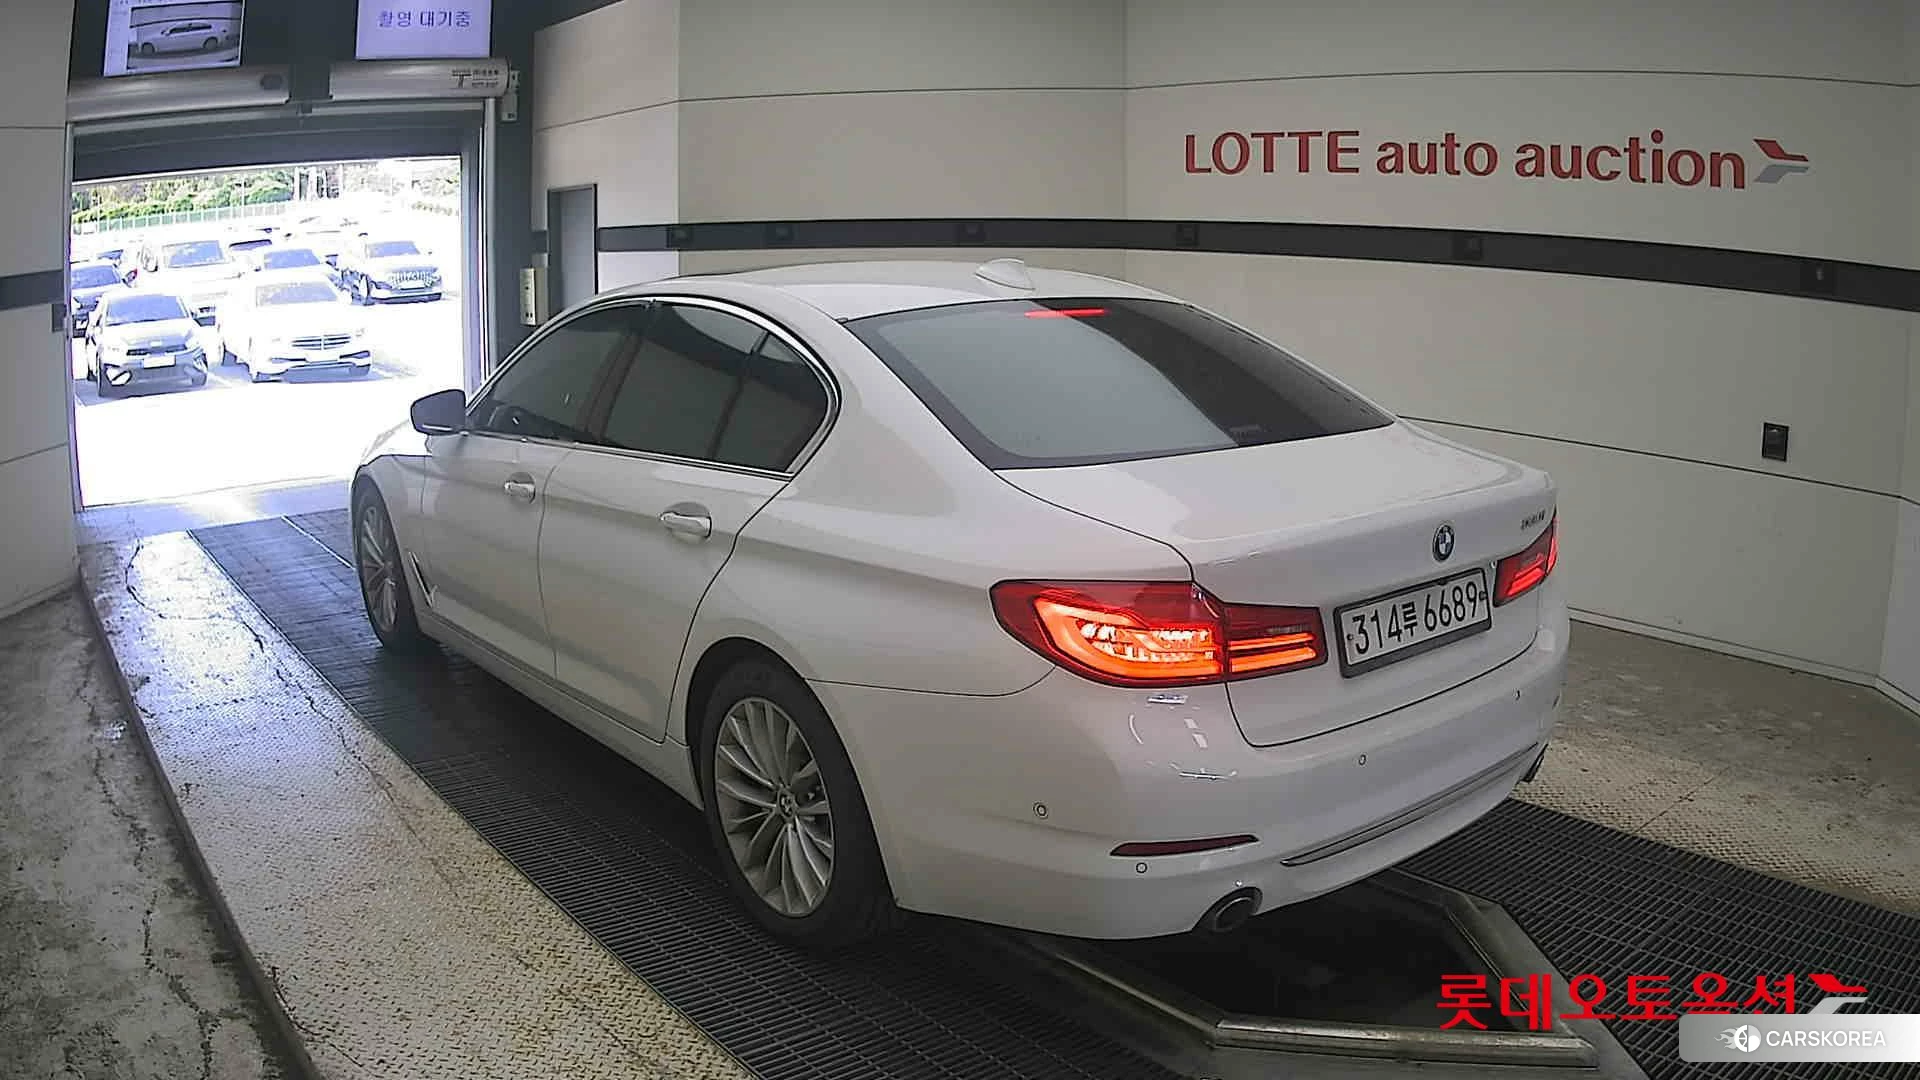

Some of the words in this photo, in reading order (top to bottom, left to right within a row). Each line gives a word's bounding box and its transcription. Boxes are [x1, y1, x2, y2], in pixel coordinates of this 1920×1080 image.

[420, 10, 471, 28] 대기중
[1185, 131, 1360, 175] LOTTE
[1376, 132, 1498, 176] auto
[1514, 129, 1745, 189] auction
